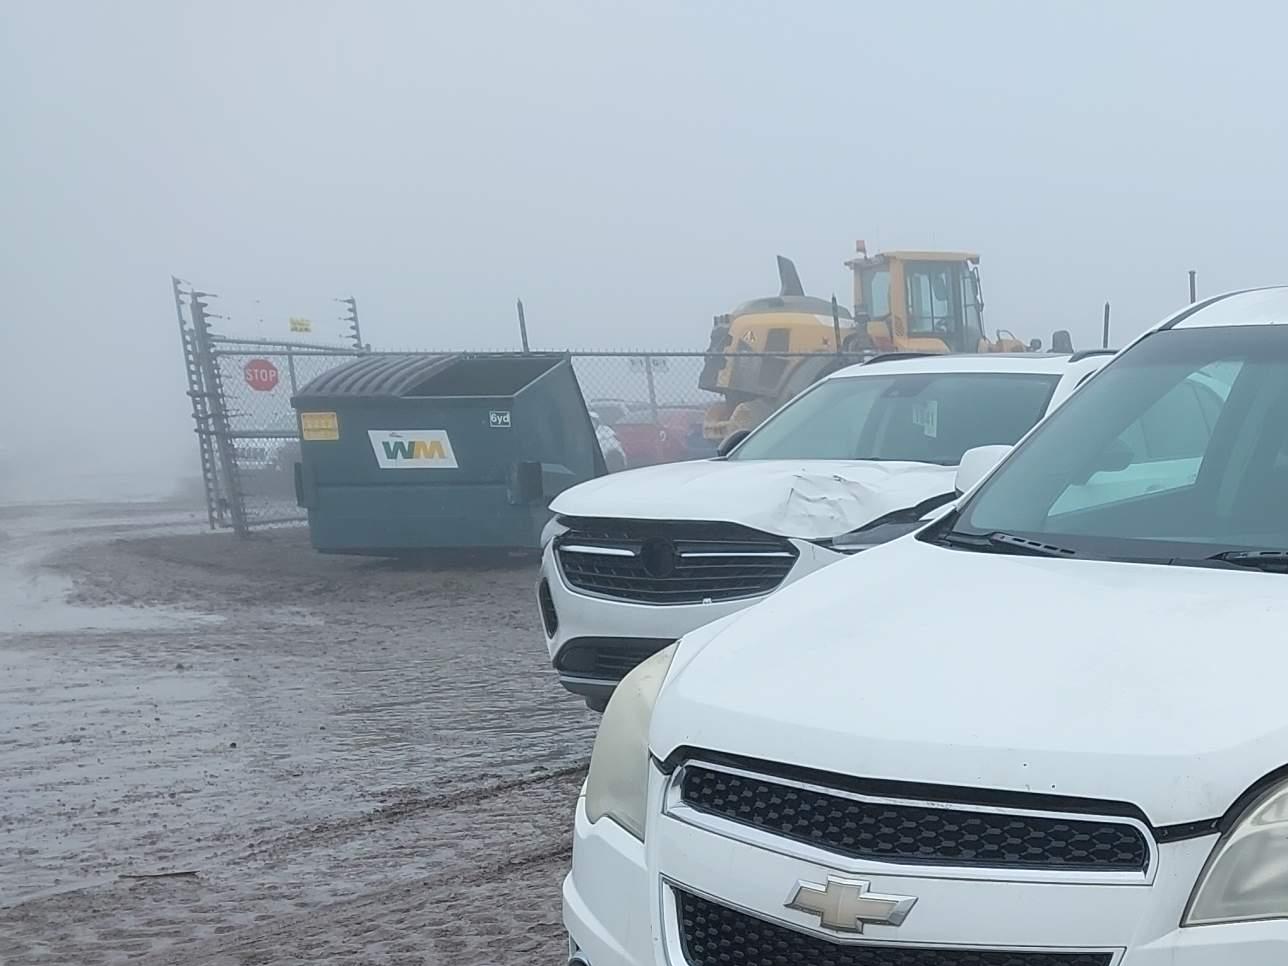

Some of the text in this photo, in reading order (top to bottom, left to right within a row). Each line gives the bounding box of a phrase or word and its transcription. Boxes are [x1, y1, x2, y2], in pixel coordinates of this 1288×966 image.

[246, 368, 276, 382] STOP
[490, 413, 510, 425] 6yd
[382, 440, 447, 460] WM
